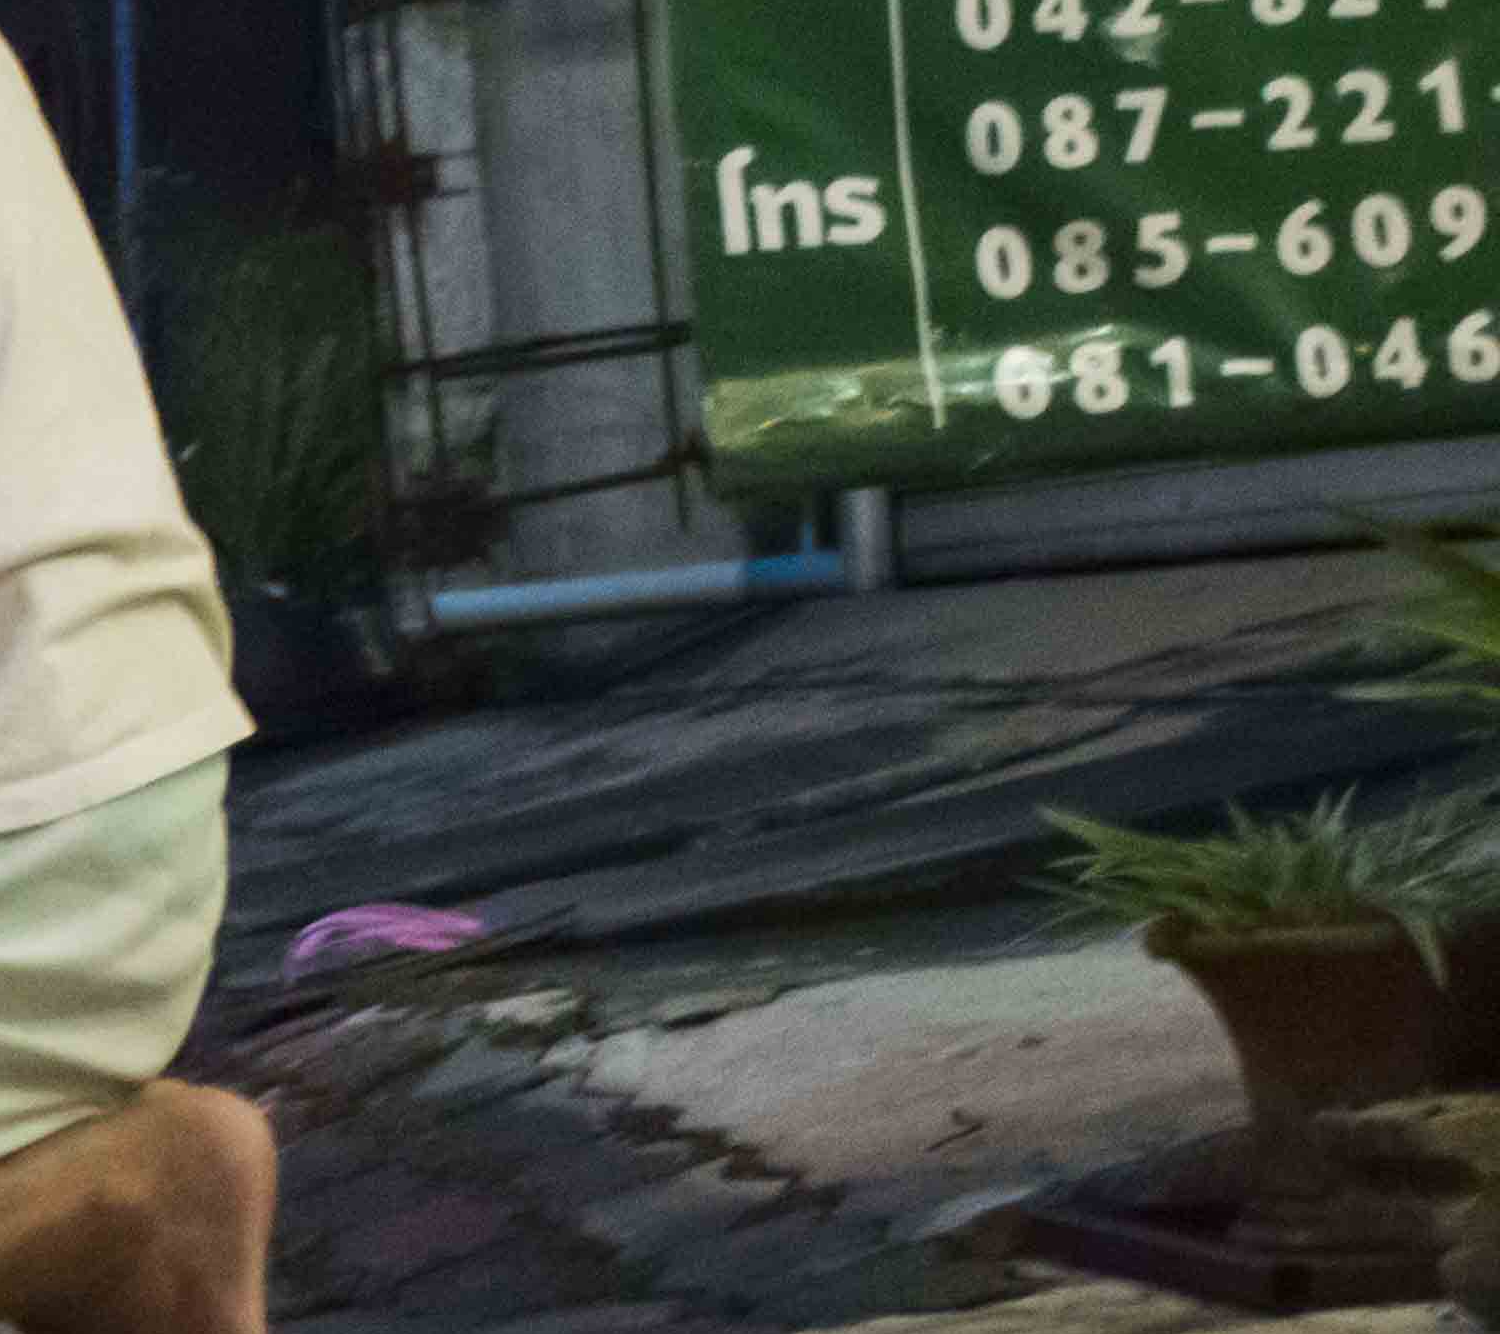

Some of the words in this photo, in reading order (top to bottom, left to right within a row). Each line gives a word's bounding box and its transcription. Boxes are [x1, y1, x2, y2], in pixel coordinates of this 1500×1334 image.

[966, 60, 1500, 177] 087-221
[716, 145, 889, 255] โทร
[975, 185, 1490, 300] 085-609
